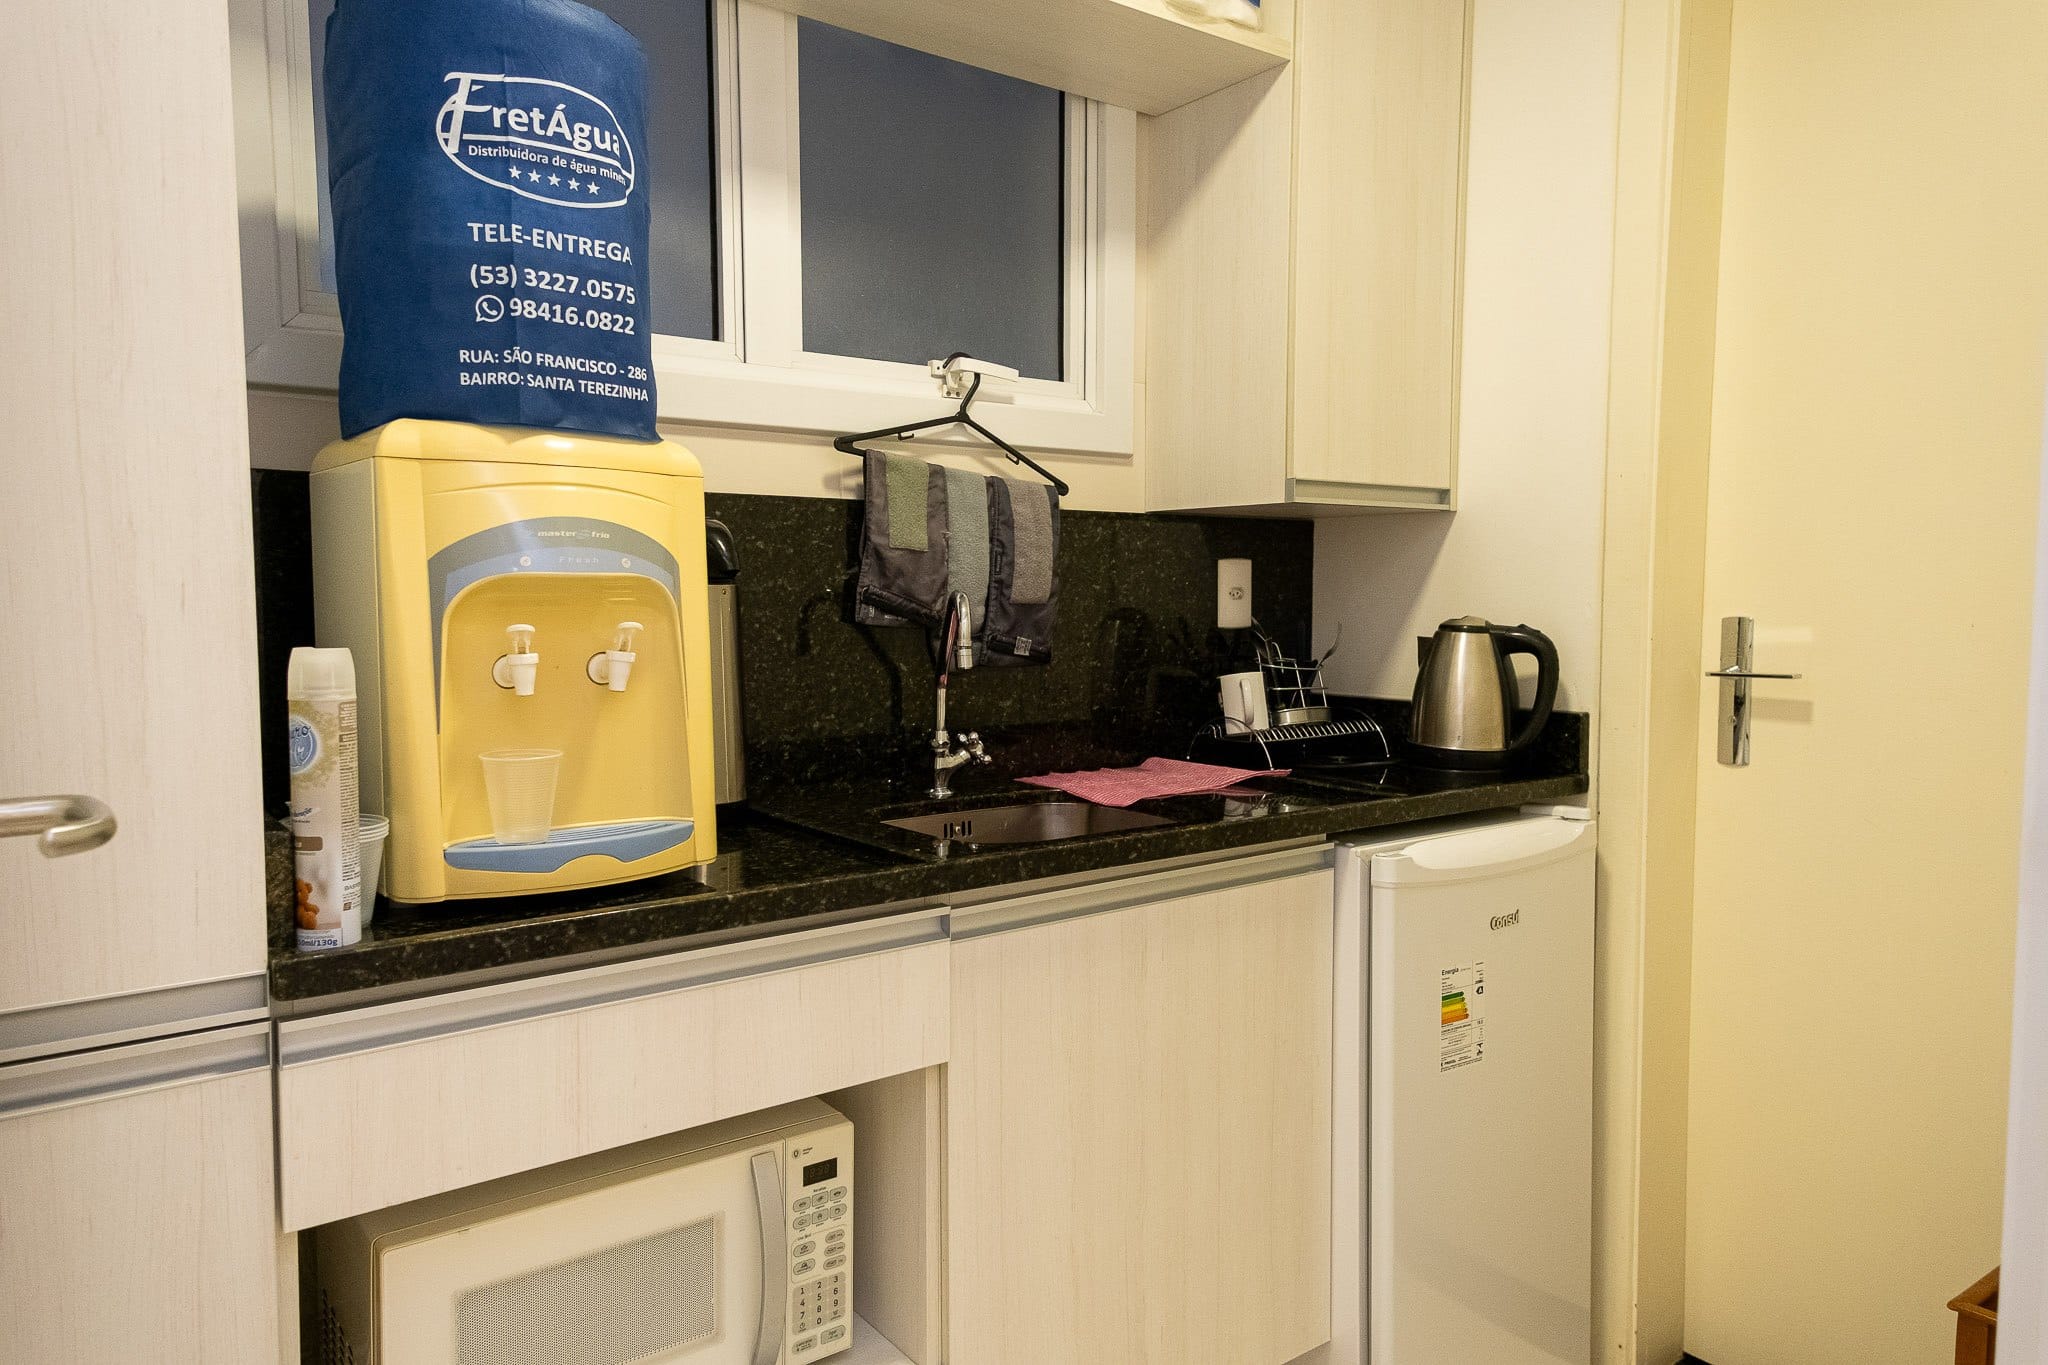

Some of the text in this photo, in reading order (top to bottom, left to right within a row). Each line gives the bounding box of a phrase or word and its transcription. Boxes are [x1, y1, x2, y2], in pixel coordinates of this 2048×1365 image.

[468, 145, 549, 164] Distribuidora
[552, 153, 567, 167] de
[570, 158, 597, 175] água
[467, 222, 633, 265] TELE-ENTREGA
[470, 264, 637, 305] (53) 3227.0575
[509, 297, 635, 335] 98416.0822
[459, 349, 499, 364] RUA:
[503, 346, 533, 364] SÃO
[536, 352, 617, 376] FRANCISCO
[628, 365, 648, 381] 286
[459, 371, 649, 402] BAIRRO: SANTA TEREZINHA
[591, 530, 610, 539] frio
[1490, 908, 1520, 931] Consul
